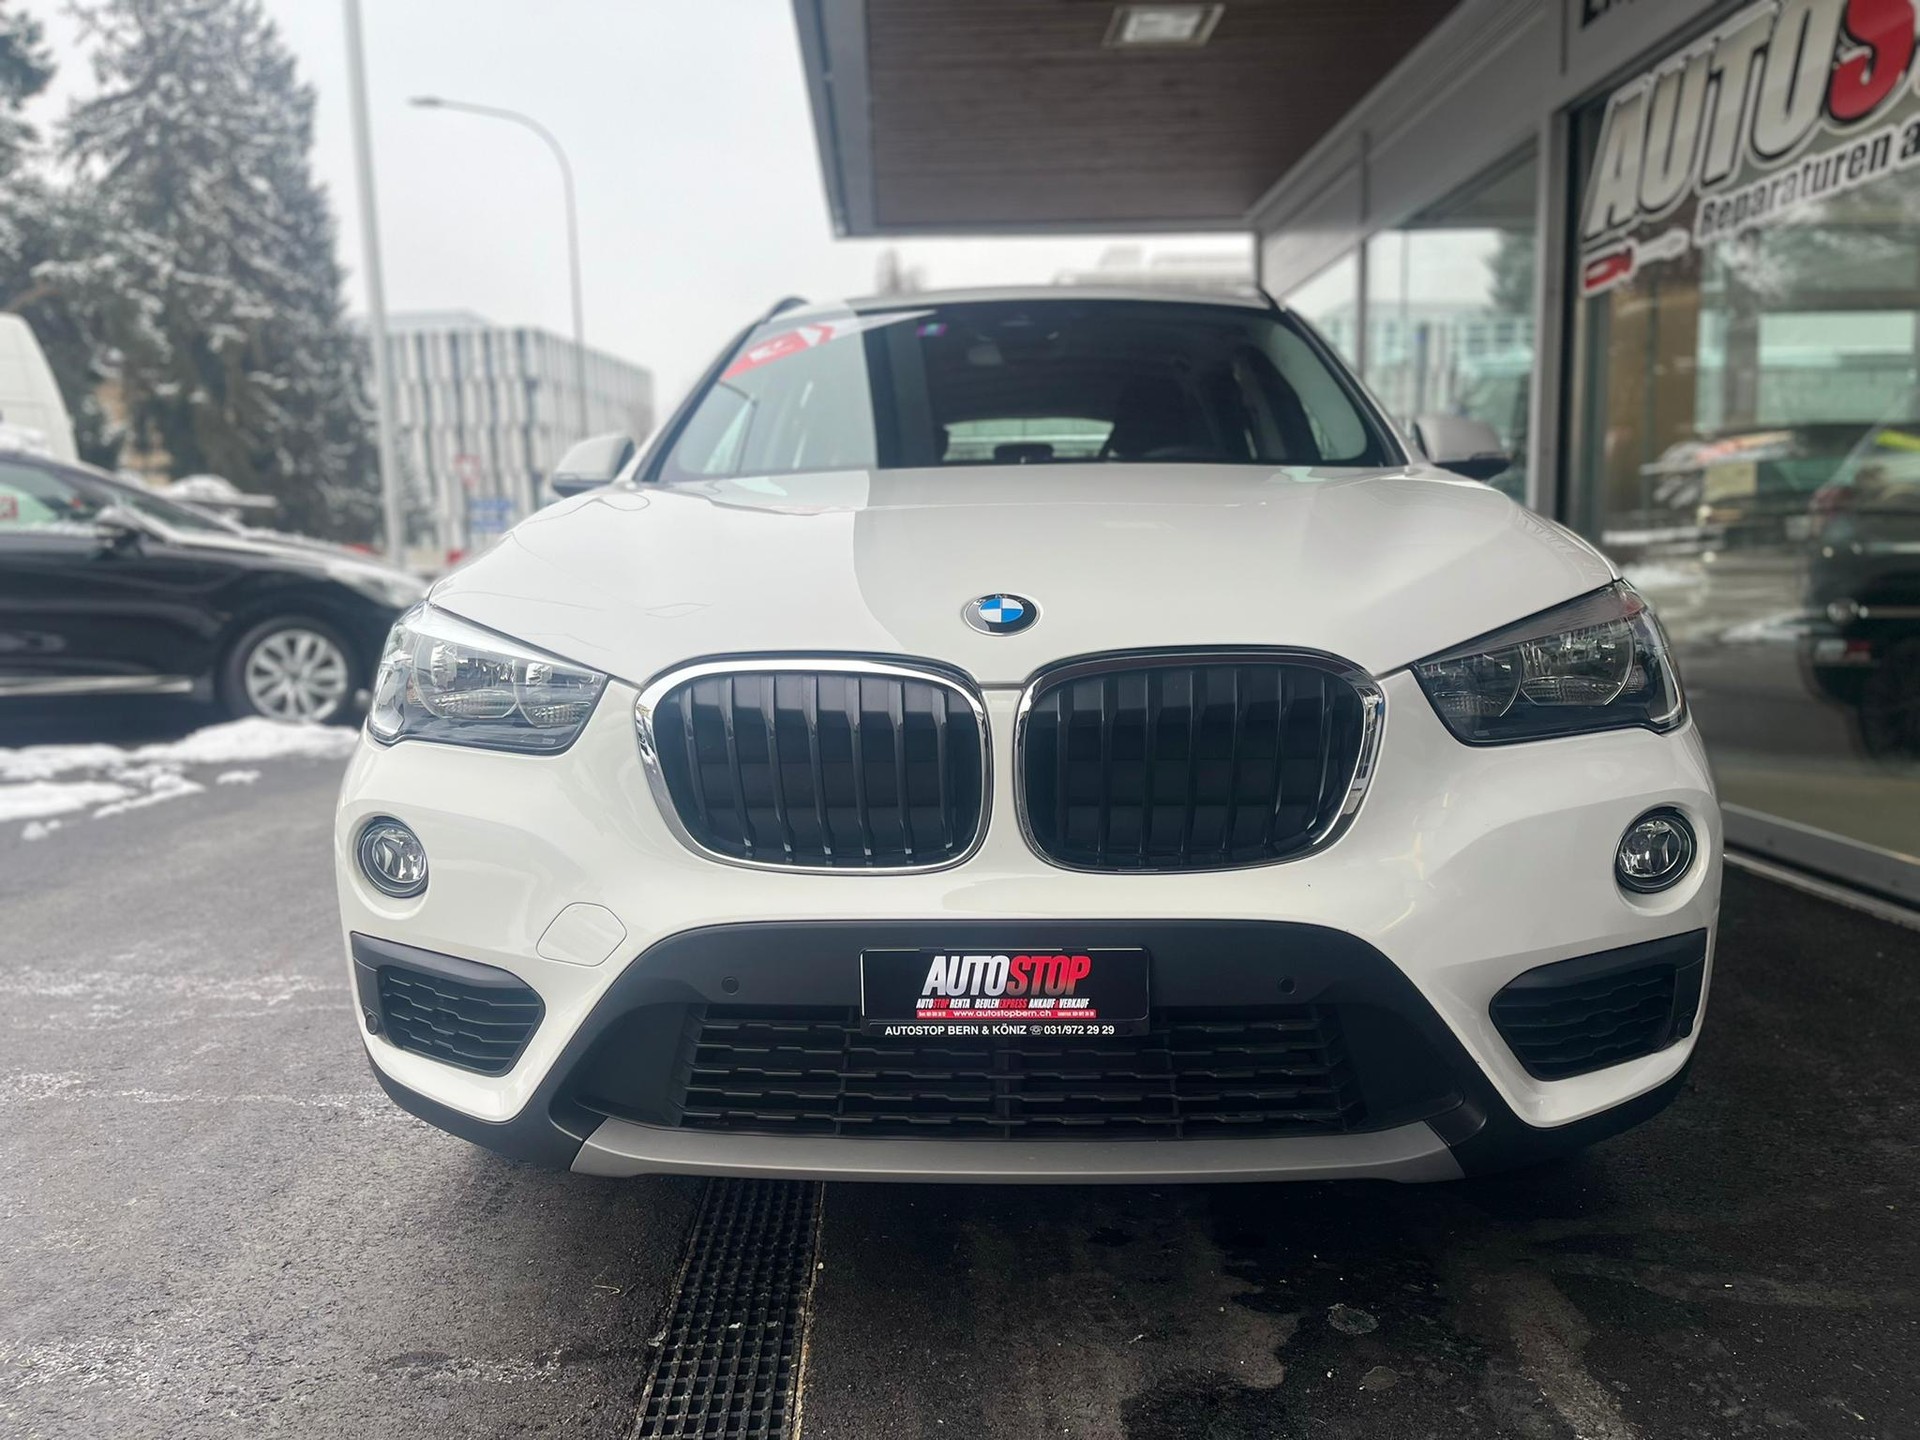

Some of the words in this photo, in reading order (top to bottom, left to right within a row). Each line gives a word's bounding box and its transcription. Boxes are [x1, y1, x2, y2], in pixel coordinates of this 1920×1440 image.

[921, 955, 1091, 996] AUTOSTOP
[953, 1009, 1051, 1018] www.autostopbern.ch
[885, 1026, 945, 1036] AUTOSTOP
[948, 1025, 979, 1035] BERN
[981, 1025, 990, 1035] &
[993, 1023, 1027, 1035] KÖNIZ
[1044, 1025, 1084, 1035] 031/972
[1087, 1025, 1099, 1035] 29
[1102, 1025, 1114, 1035] 29
